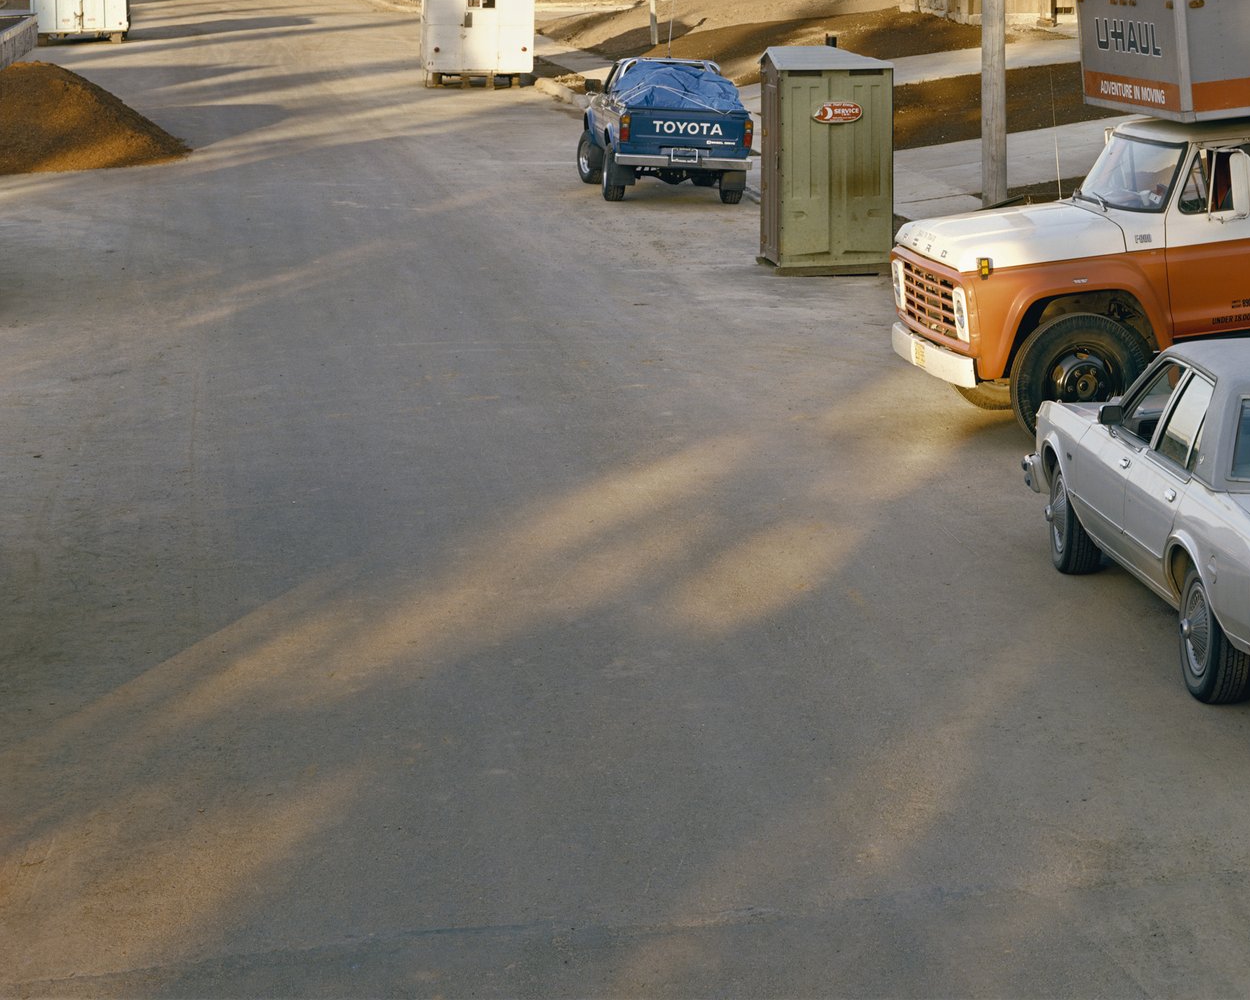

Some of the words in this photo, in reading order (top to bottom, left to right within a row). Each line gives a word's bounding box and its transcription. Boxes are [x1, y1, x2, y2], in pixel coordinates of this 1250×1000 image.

[1095, 17, 1162, 58] U-HAUL
[1100, 80, 1133, 99] ADVENTURE
[1133, 83, 1141, 101] IN
[1141, 85, 1166, 105] MOVING
[653, 120, 723, 136] TOYOTA
[1212, 314, 1234, 325] UNDER
